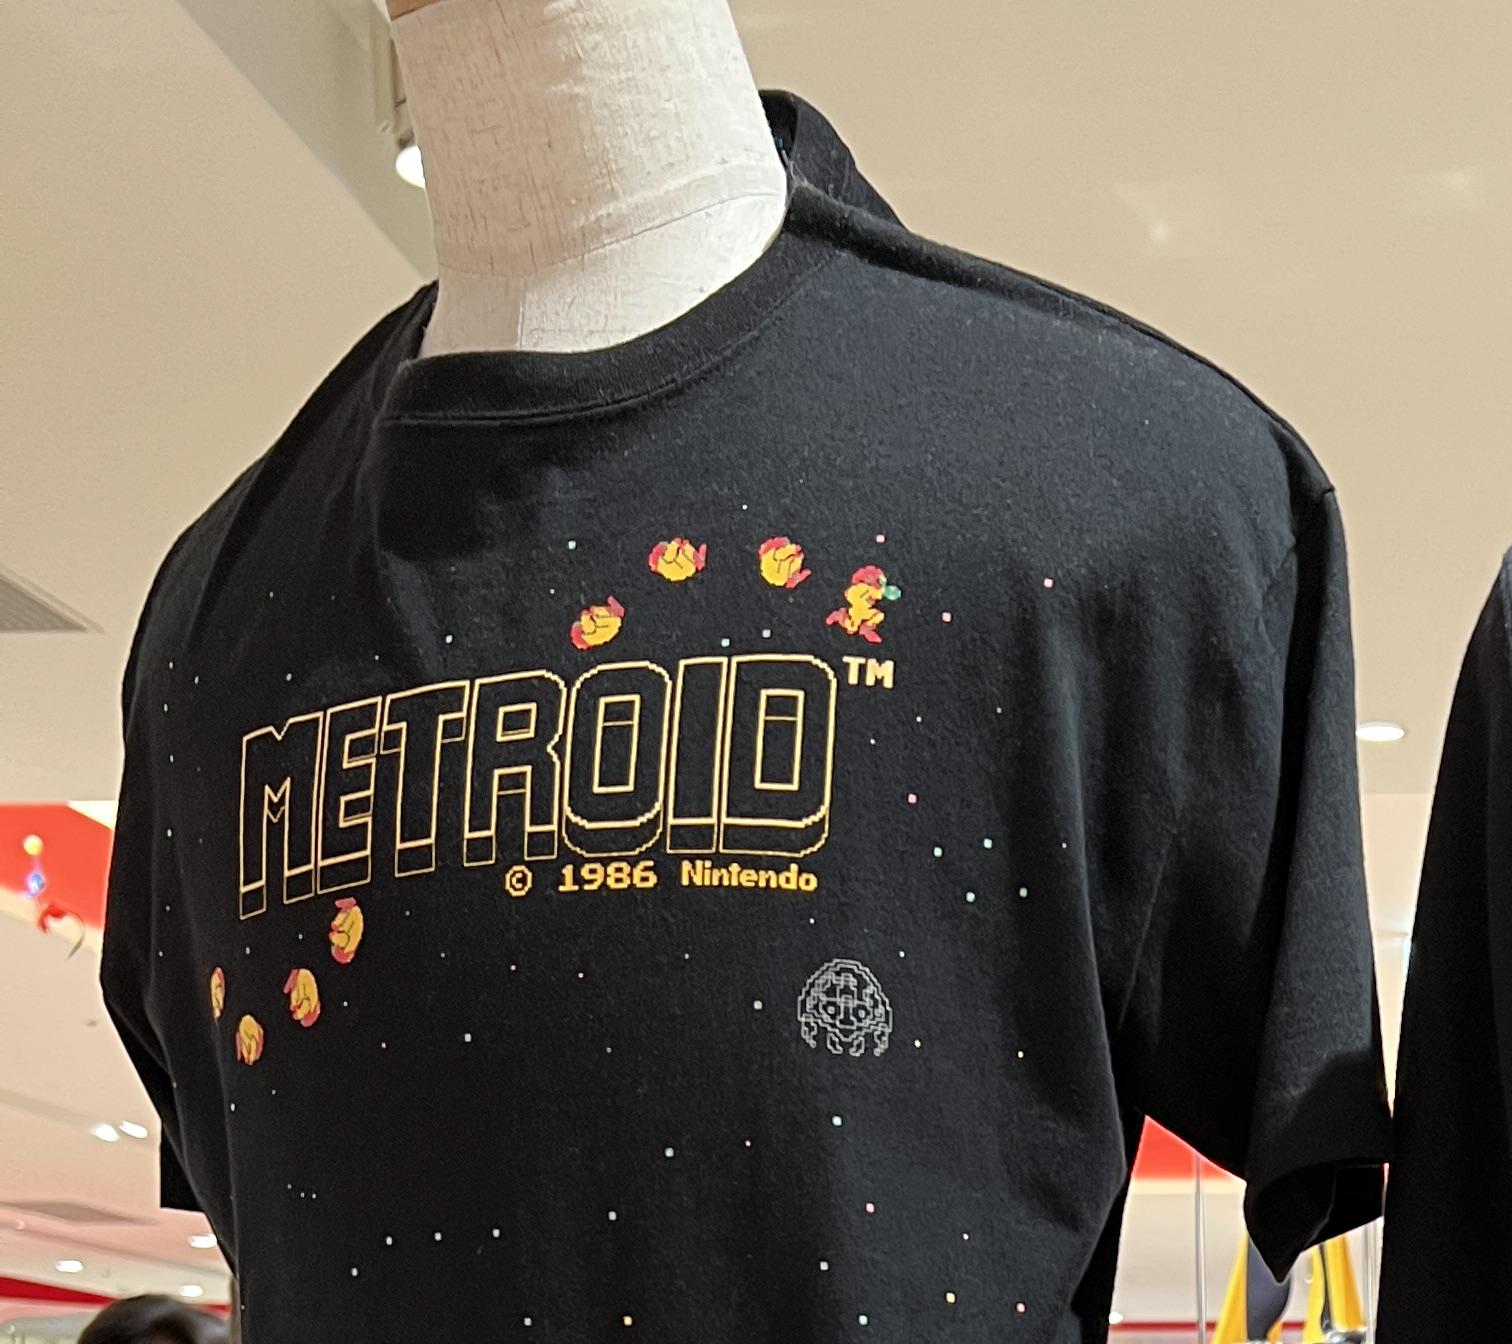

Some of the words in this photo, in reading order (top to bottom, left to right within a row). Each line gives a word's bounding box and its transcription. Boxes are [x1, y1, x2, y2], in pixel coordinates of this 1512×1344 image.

[240, 653, 837, 919] METROID
[559, 860, 658, 892] 1986
[681, 860, 818, 892] Nintendo
